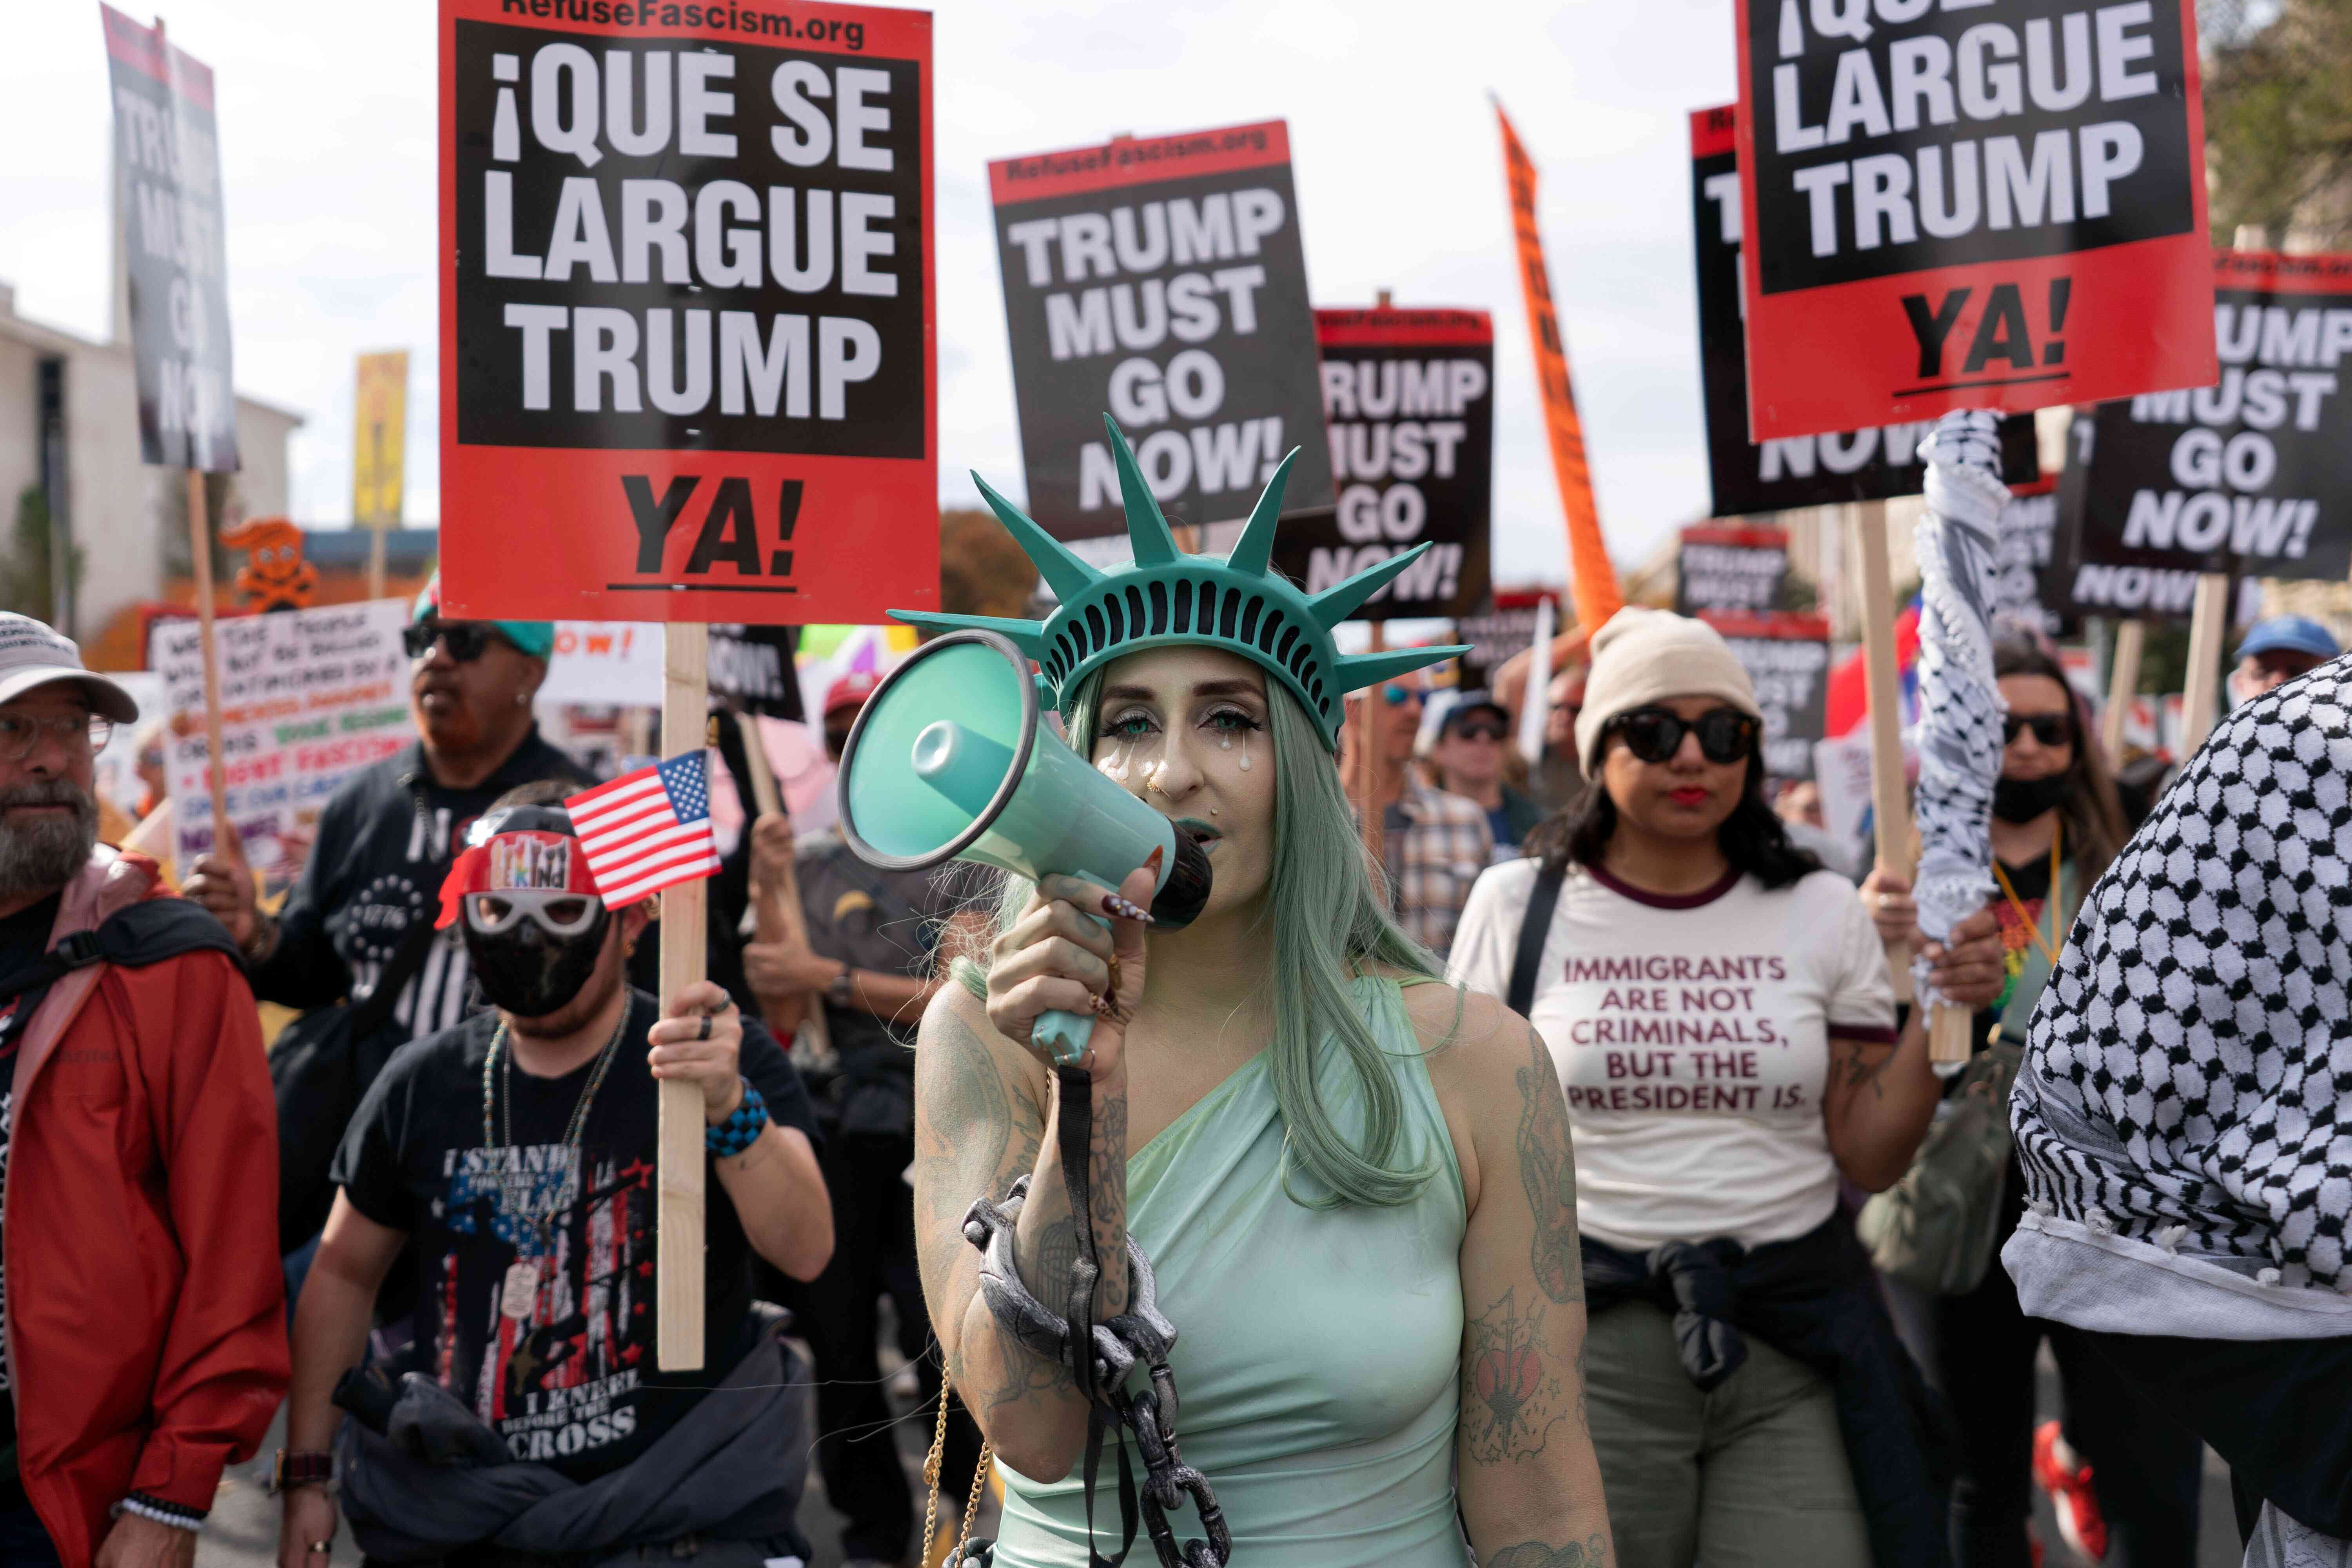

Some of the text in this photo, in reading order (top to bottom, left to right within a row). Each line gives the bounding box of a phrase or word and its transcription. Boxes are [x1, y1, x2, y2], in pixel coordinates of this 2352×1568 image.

[501, 0, 865, 50] RefuseFascism.org
[493, 42, 894, 171] ¡QUE SE
[1773, 0, 2159, 154] LARGUE
[1006, 128, 1269, 181] RefuseFascism.org
[1793, 120, 2144, 258] TRUMP
[485, 169, 898, 297] LARGUE
[1008, 187, 1285, 287] TRUMP
[1045, 265, 1265, 361] MUST
[1900, 276, 2072, 379] YA!
[2215, 305, 2352, 367] UMP
[504, 303, 882, 421] TRUMP
[1108, 349, 1226, 428] GO
[1321, 358, 1489, 419] RUMP
[1078, 416, 1283, 511] NOW!
[2170, 427, 2277, 493] GO
[620, 474, 805, 577] YA!
[1336, 482, 1427, 543] GO
[2121, 489, 2318, 559] NOW!
[2072, 564, 2198, 612] NOW
[1564, 955, 1788, 982] IMMIGRANTS
[1599, 987, 1755, 1012] ARE NOT
[1571, 1018, 1789, 1049] CRIMINALS,
[1606, 1051, 1759, 1080] BUT THE
[1567, 1084, 1762, 1111] PRESIDENT
[443, 1144, 581, 1177] I STAND
[502, 1396, 610, 1435] BEFORE THE
[525, 1367, 643, 1415] I KNEEL
[506, 1404, 637, 1461] CROSS
